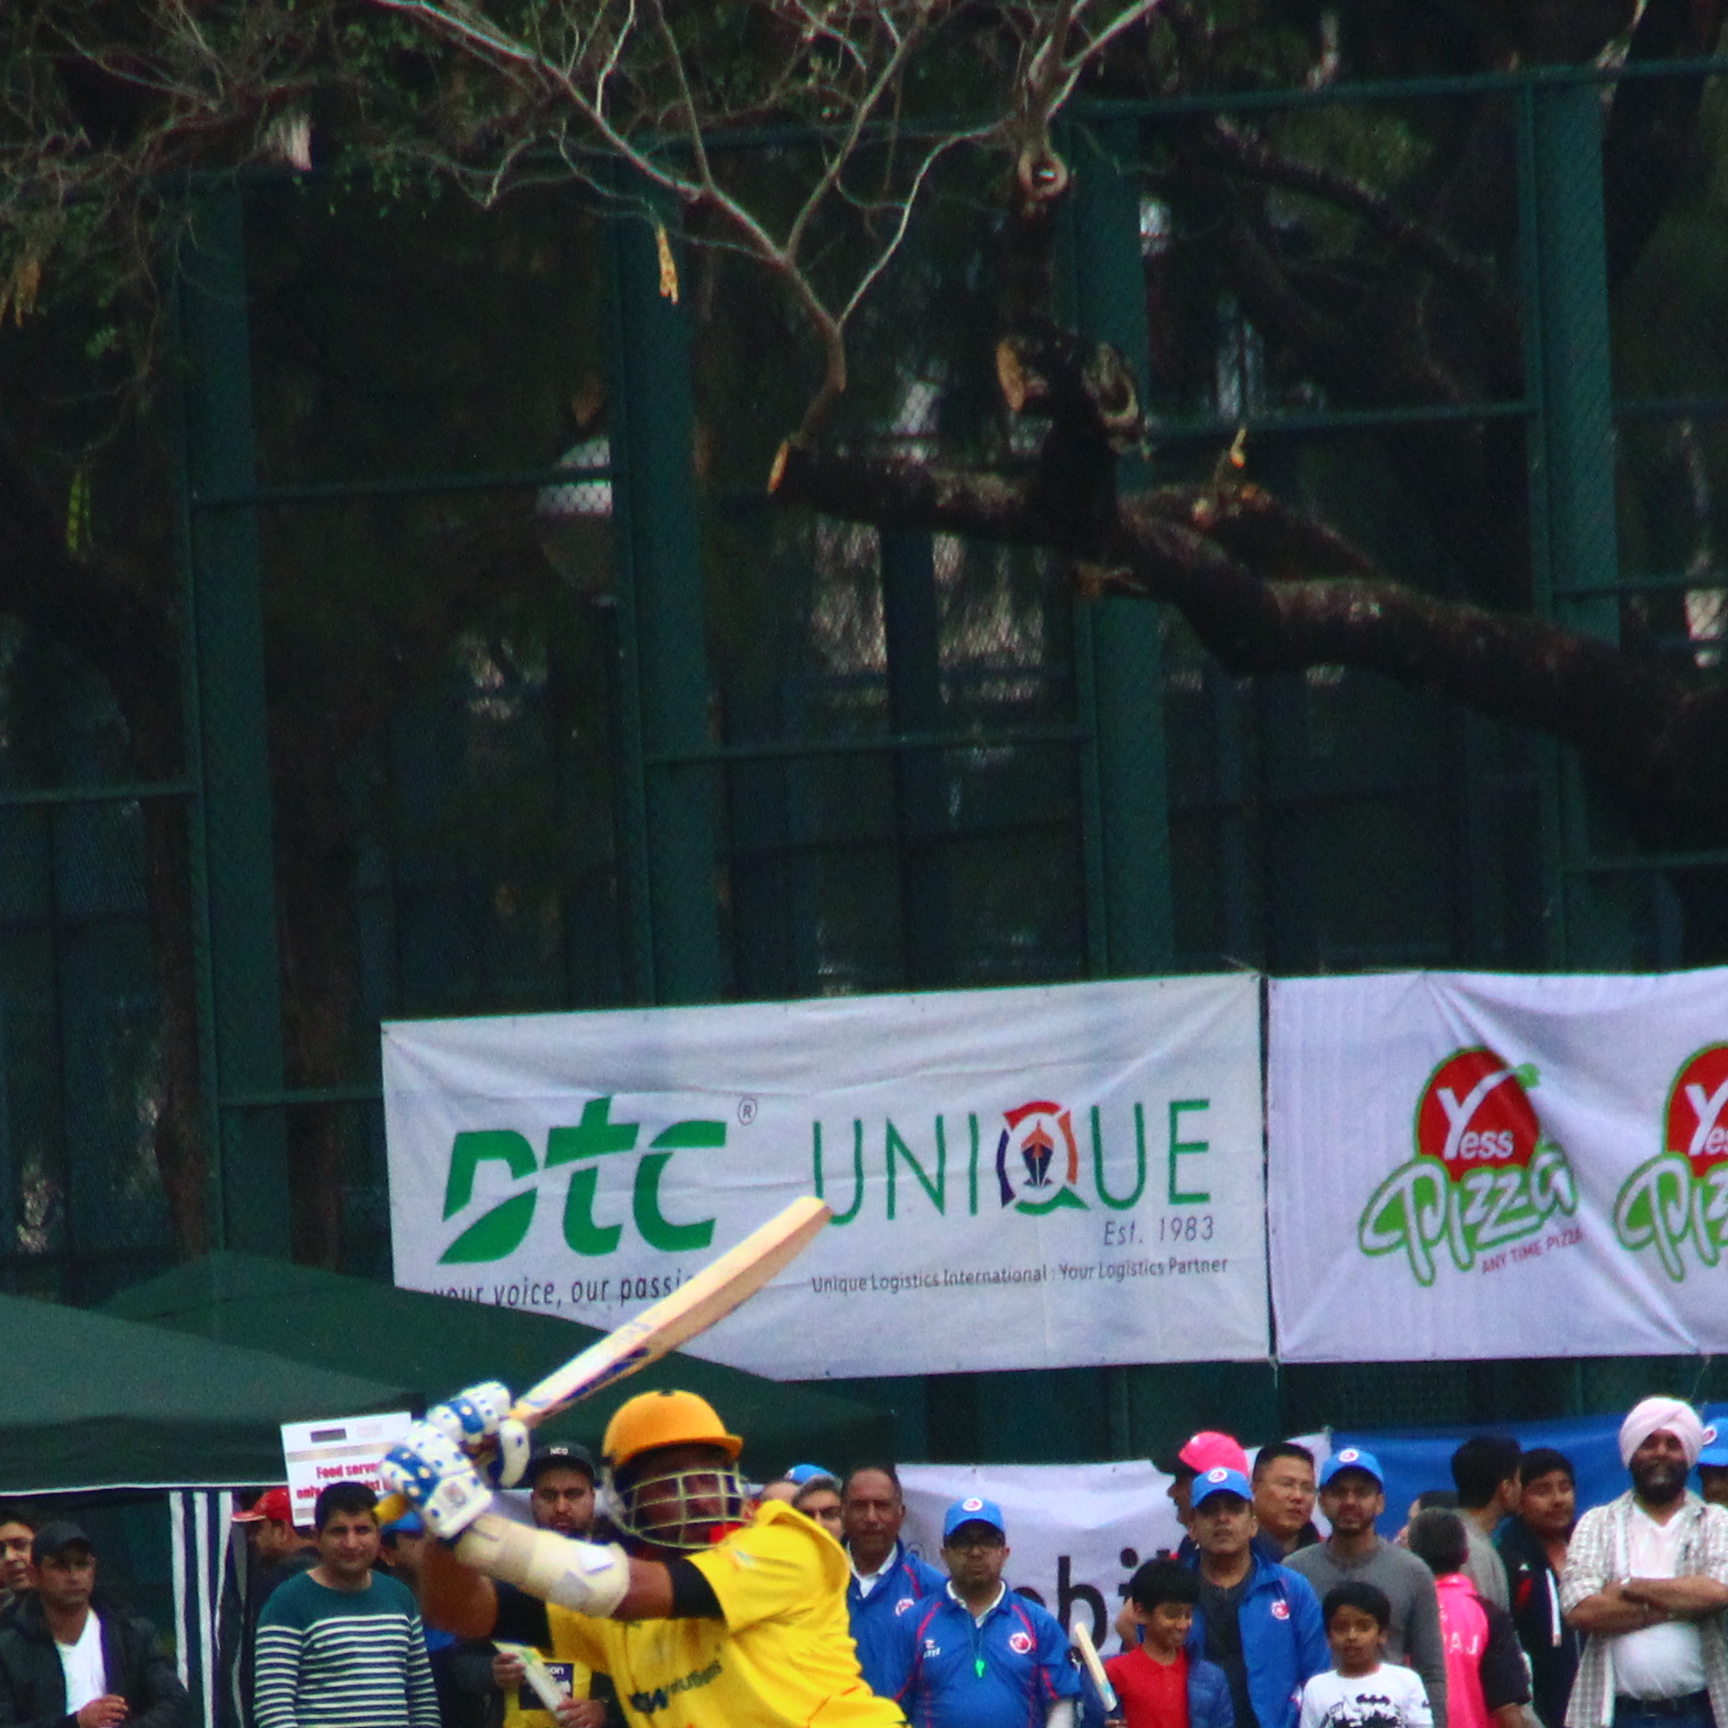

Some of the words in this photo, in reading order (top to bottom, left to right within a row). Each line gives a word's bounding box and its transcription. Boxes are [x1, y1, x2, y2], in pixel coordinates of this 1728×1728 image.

[1436, 1066, 1524, 1160] Yess
[812, 1098, 1212, 1227] UNIQUE
[1103, 1219, 1143, 1247] Est.
[1158, 1215, 1214, 1242] 1983
[1360, 1149, 1575, 1286] Pizza
[1546, 1227, 1584, 1250] PIZZA
[494, 1276, 562, 1310] voice,
[571, 1276, 610, 1302] our
[811, 1275, 867, 1295] Unique
[871, 1272, 940, 1295] Logistics
[943, 1266, 1048, 1288] International
[1058, 1262, 1096, 1282] Your
[1099, 1257, 1165, 1281] Logistics
[1168, 1255, 1229, 1277] Partner
